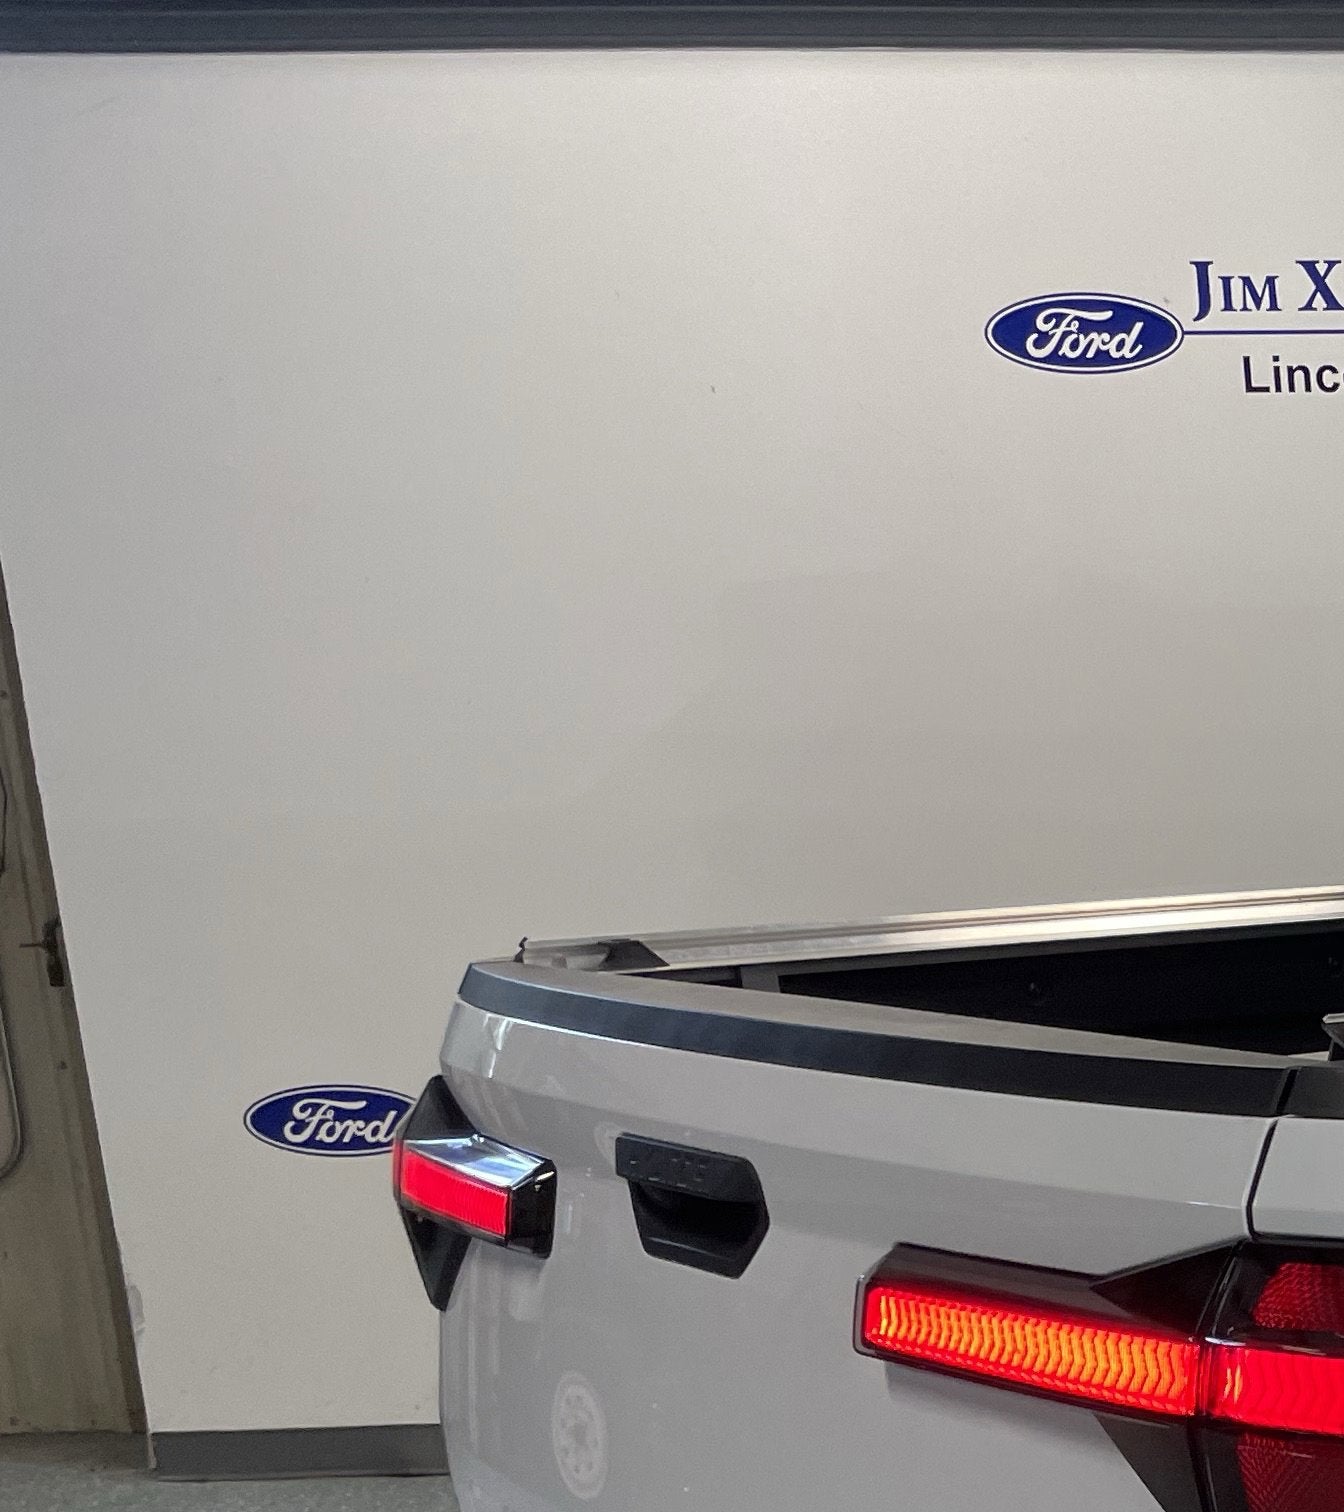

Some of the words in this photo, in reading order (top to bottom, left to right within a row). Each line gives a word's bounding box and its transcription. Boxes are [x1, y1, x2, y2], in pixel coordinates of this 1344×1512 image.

[1189, 260, 1283, 323] JIM
[1024, 307, 1144, 361] Ford
[283, 1098, 398, 1144] Ford
